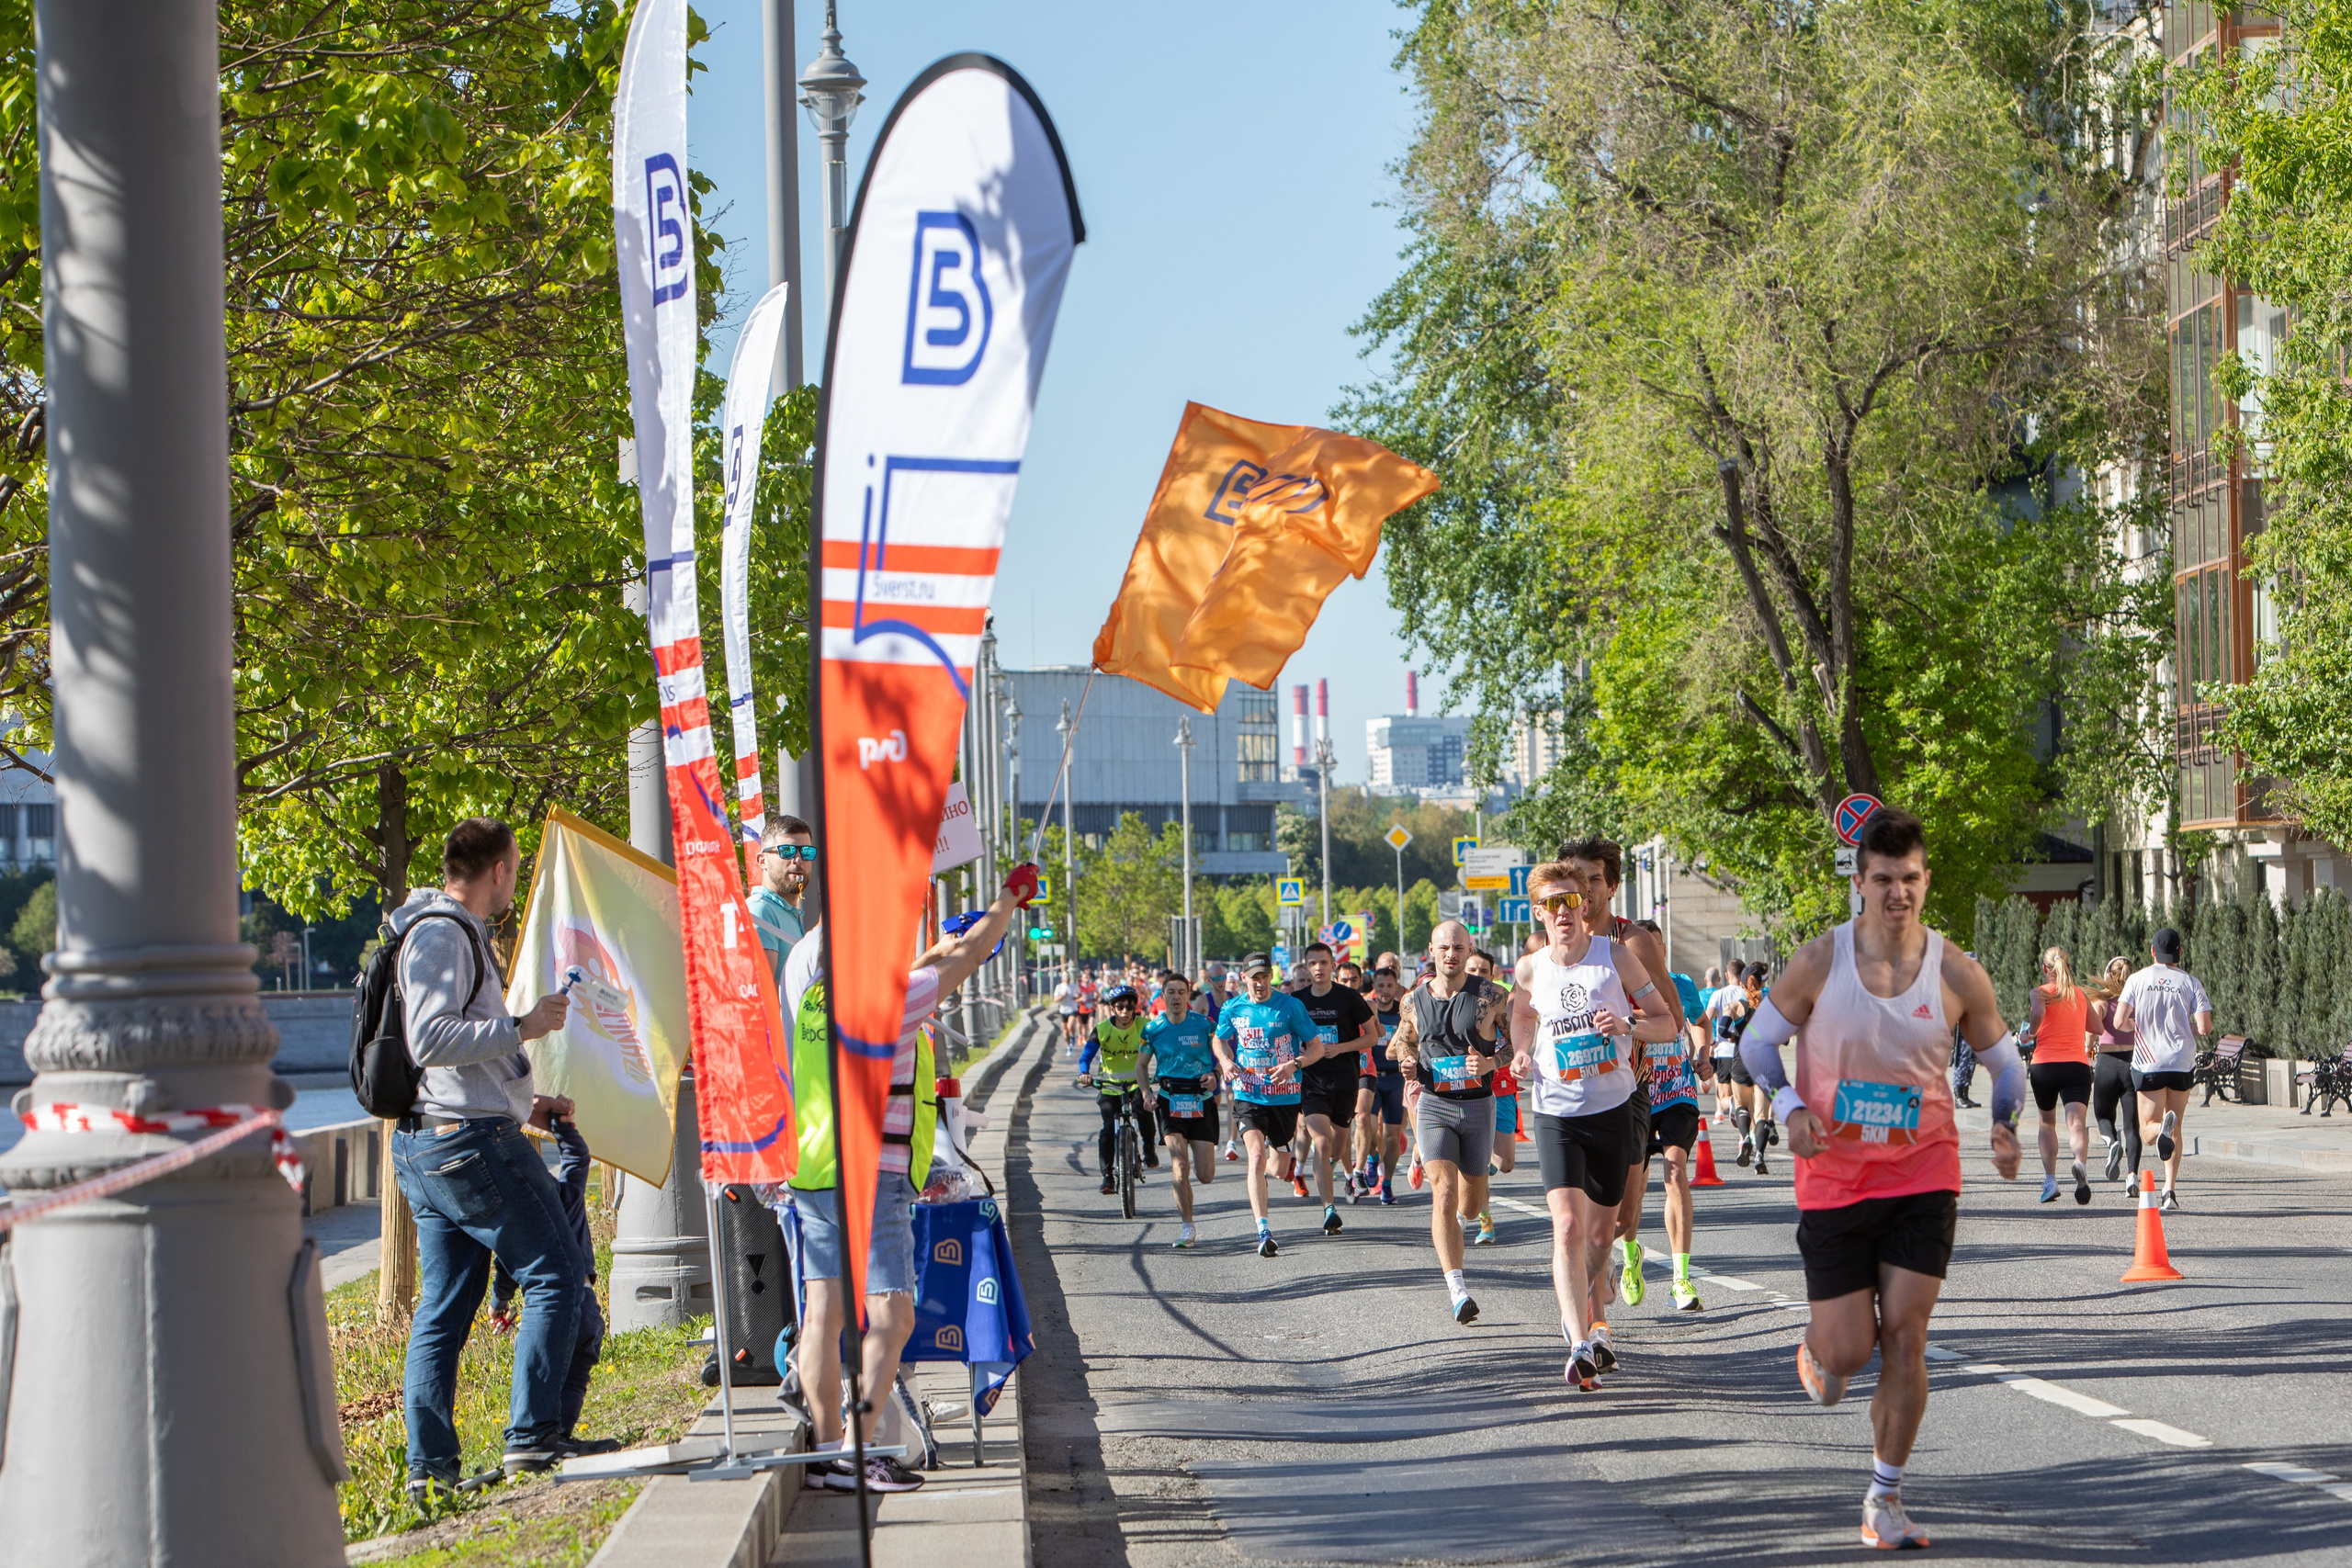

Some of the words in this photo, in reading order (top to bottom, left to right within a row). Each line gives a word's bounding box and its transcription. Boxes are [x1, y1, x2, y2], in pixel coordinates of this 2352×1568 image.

[1567, 1045, 1605, 1066] 26977
[1645, 1042, 1675, 1056] 23073
[1250, 1056, 1271, 1066] 21452
[1653, 1055, 1668, 1066] 5KM
[1579, 1063, 1600, 1079] 5KM
[1450, 1079, 1466, 1091] 5KM
[1176, 1100, 1197, 1111] 25254
[1851, 1099, 1904, 1125] 21234
[1860, 1123, 1890, 1145] 5KM
